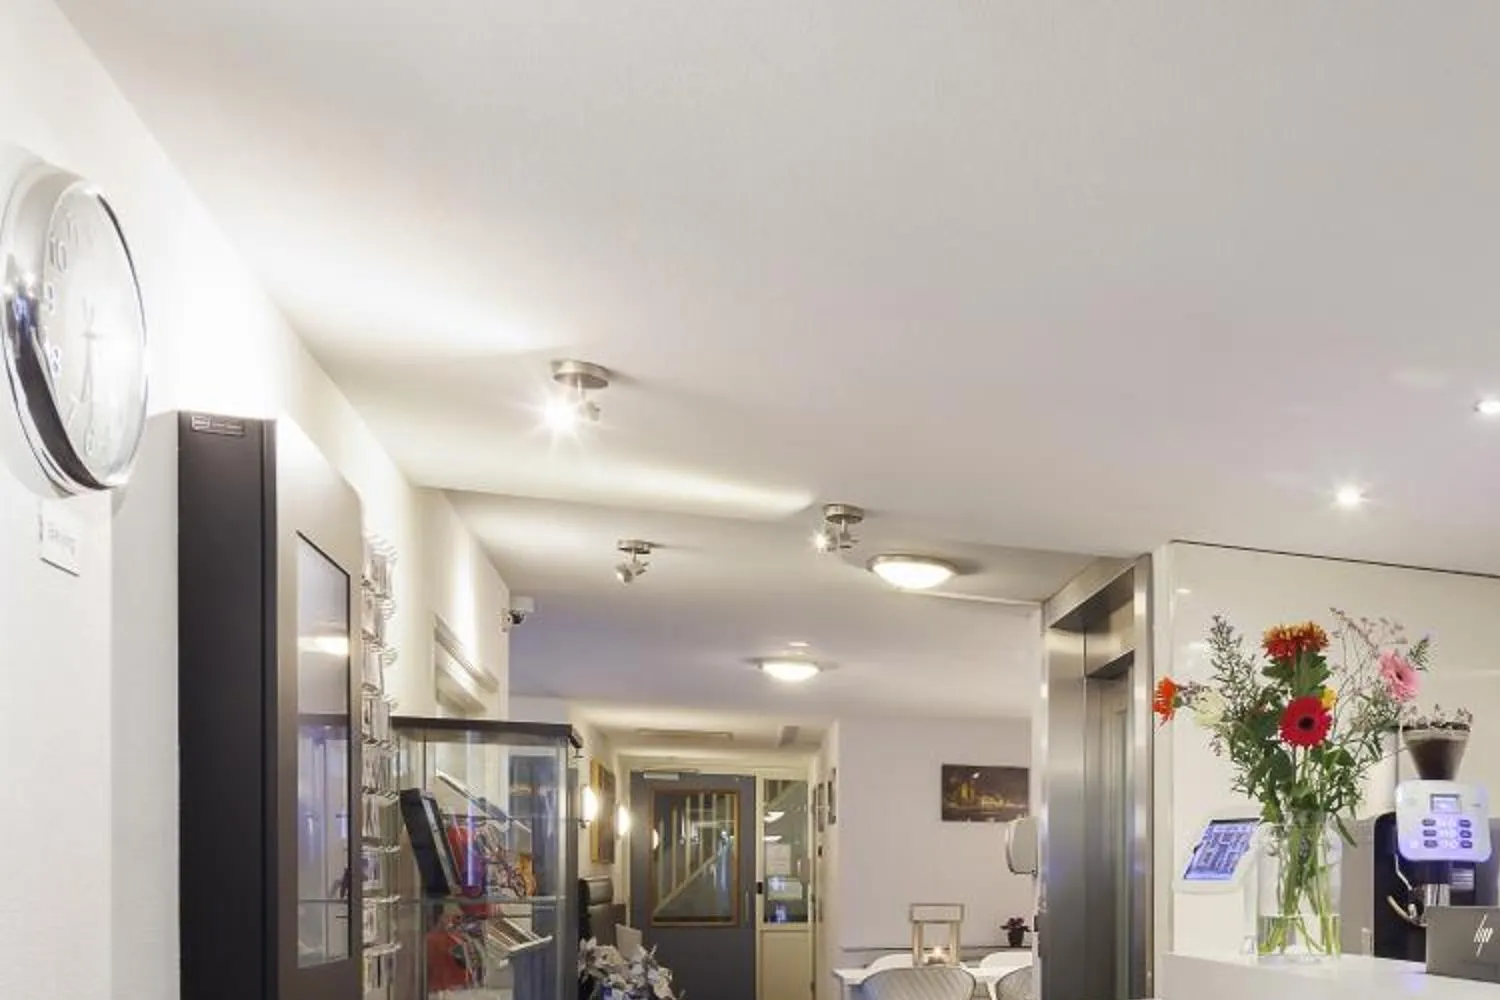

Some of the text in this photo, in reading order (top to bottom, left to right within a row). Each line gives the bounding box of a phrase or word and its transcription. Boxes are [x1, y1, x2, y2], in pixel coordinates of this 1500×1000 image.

[49, 235, 68, 274] 10
[52, 346, 61, 377] 8
[1473, 913, 1493, 957] hp
